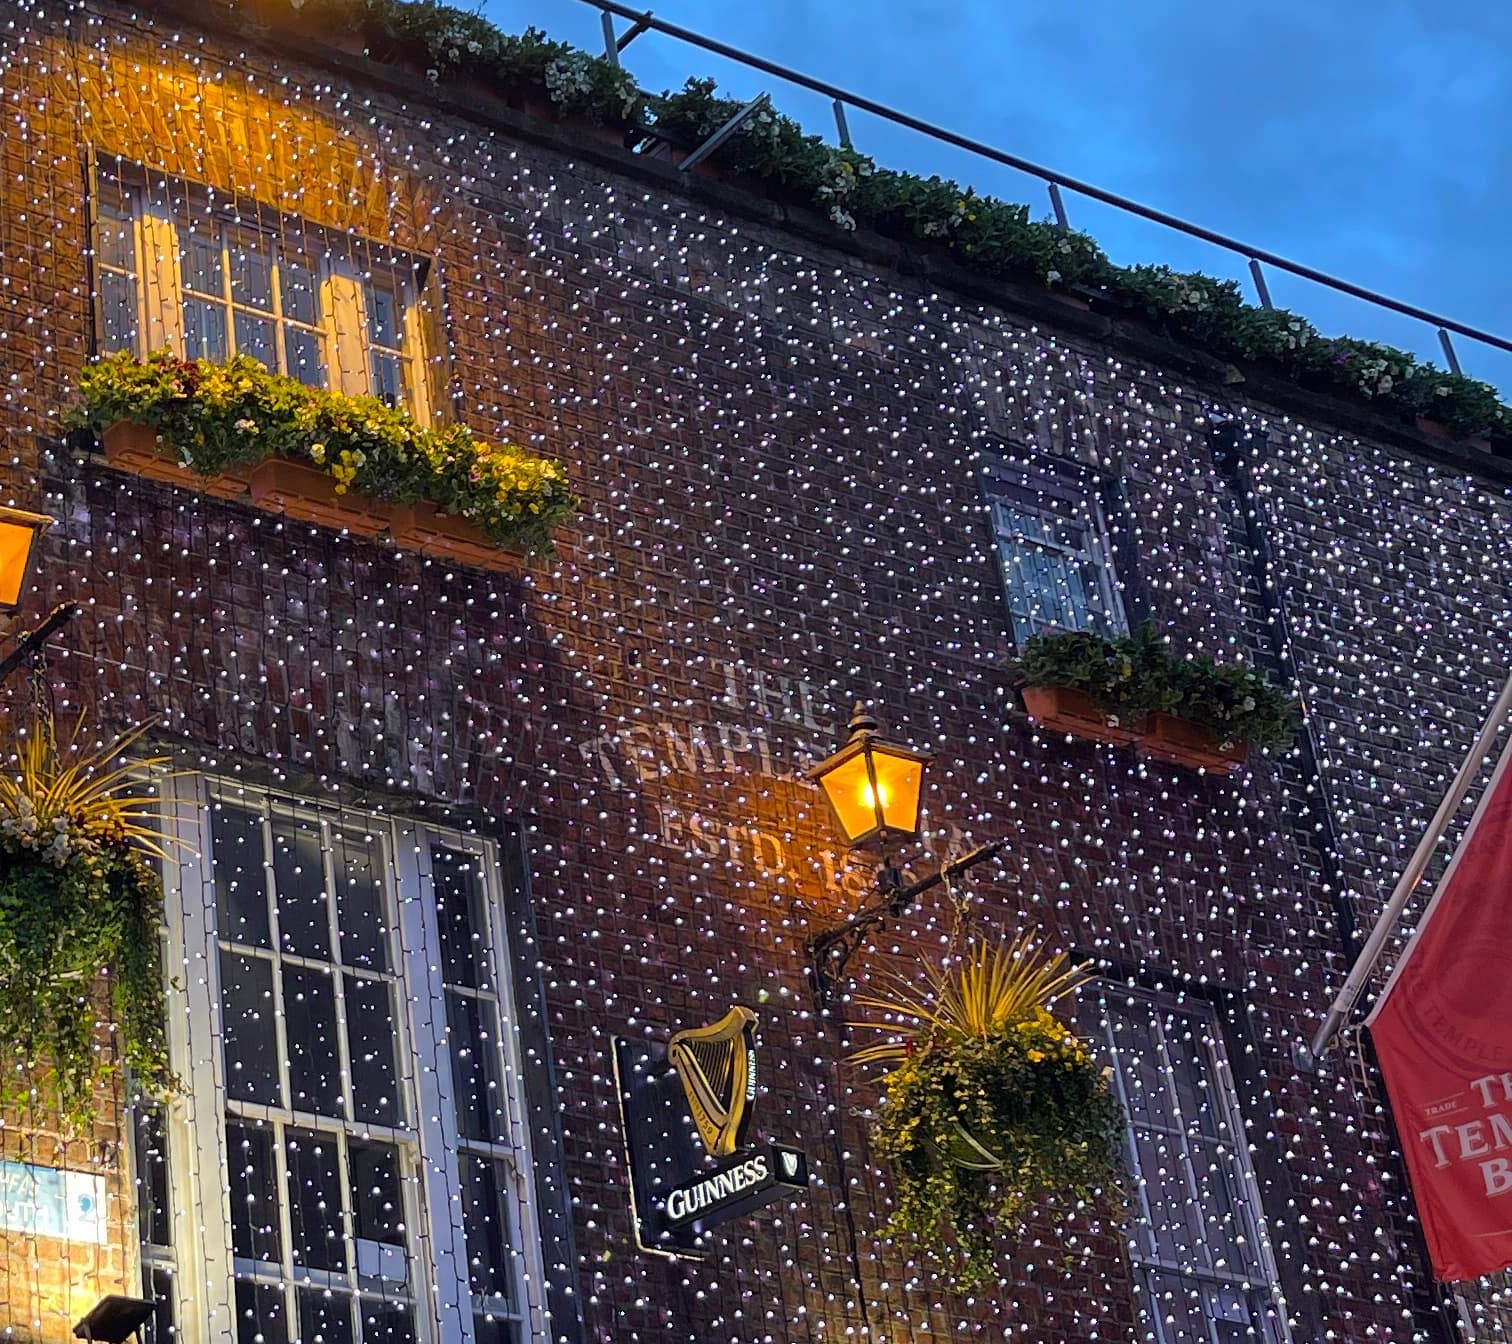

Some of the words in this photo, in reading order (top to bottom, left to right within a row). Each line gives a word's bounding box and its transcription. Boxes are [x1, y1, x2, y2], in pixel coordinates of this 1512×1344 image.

[712, 658, 836, 735] THE
[578, 722, 826, 793] TEMPLE
[746, 1049, 757, 1101] GUINNESS
[1424, 1100, 1458, 1116] TRADE
[666, 1155, 769, 1219] GUINNESS
